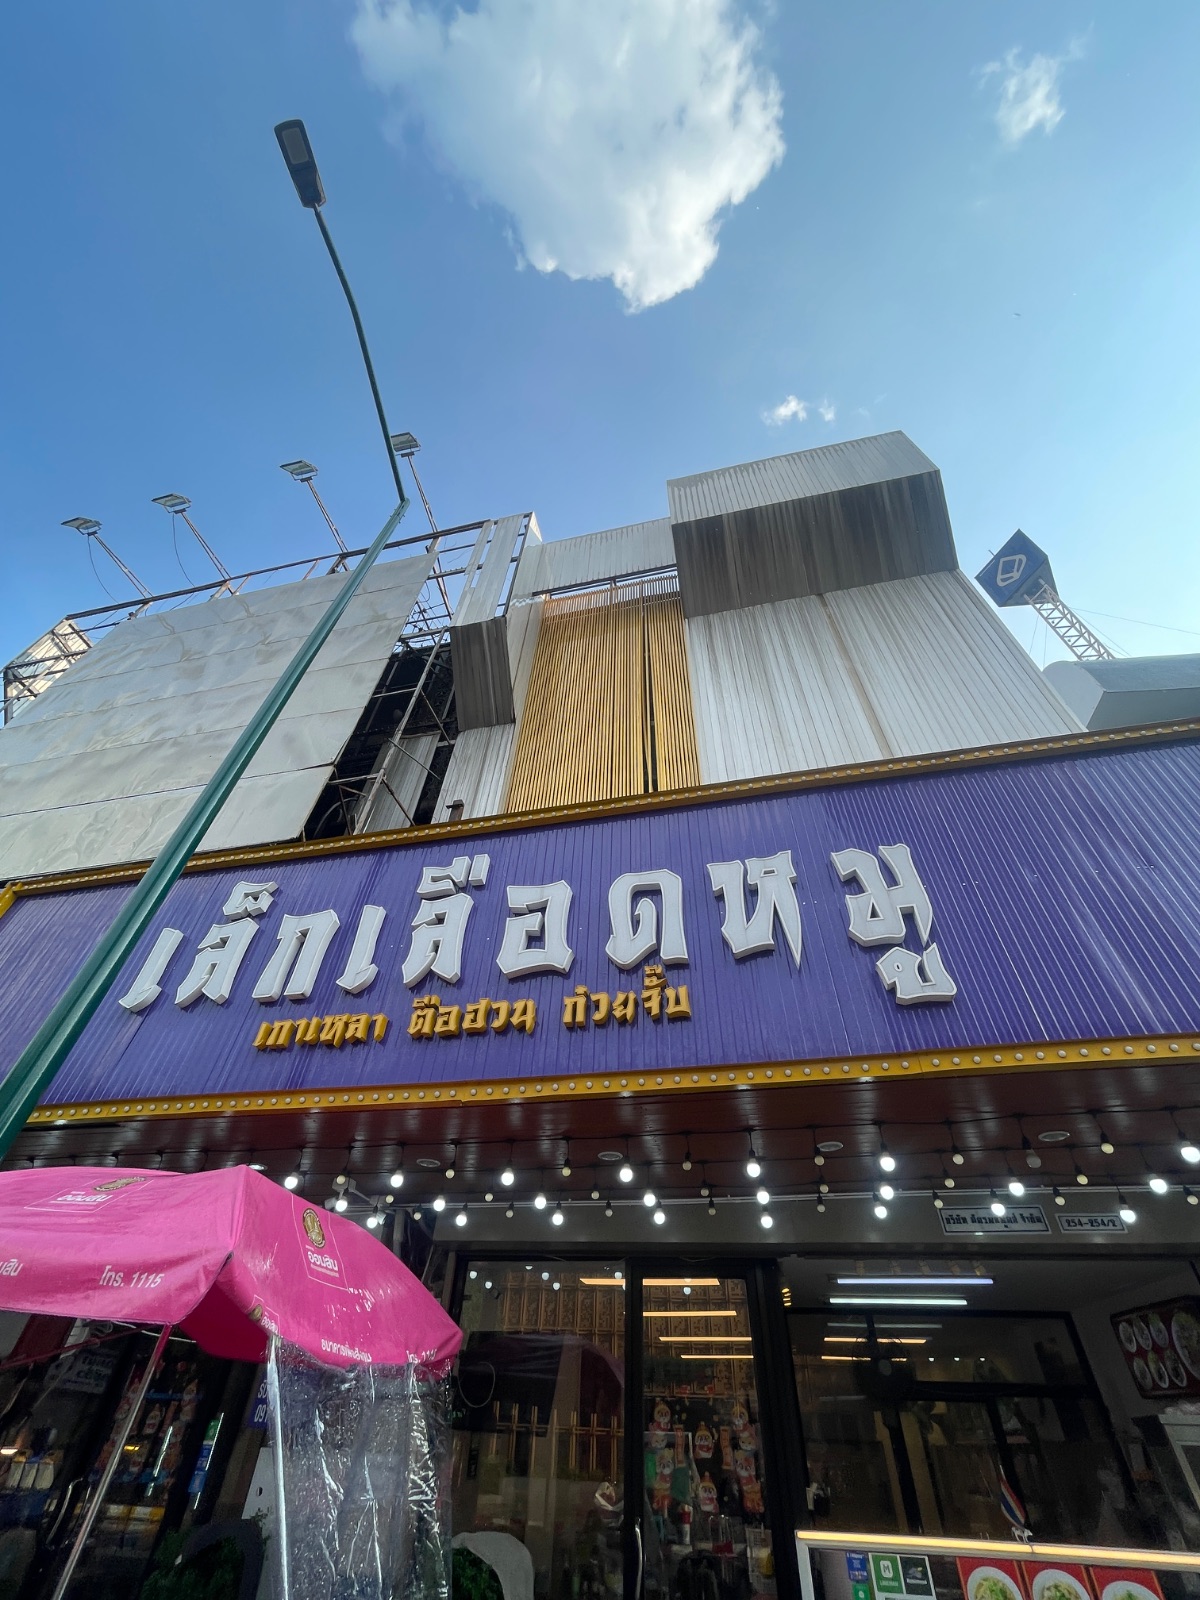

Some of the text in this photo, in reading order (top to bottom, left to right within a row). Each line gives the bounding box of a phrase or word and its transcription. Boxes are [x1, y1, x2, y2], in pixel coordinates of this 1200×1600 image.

[119, 843, 957, 1013] เล็กเลือดหมู
[252, 1012, 389, 1050] เกาเหลา
[1065, 1217, 1118, 1228] 254-254/2
[307, 1250, 339, 1272] ออมสิน
[98, 1265, 165, 1289] โทร. 1115
